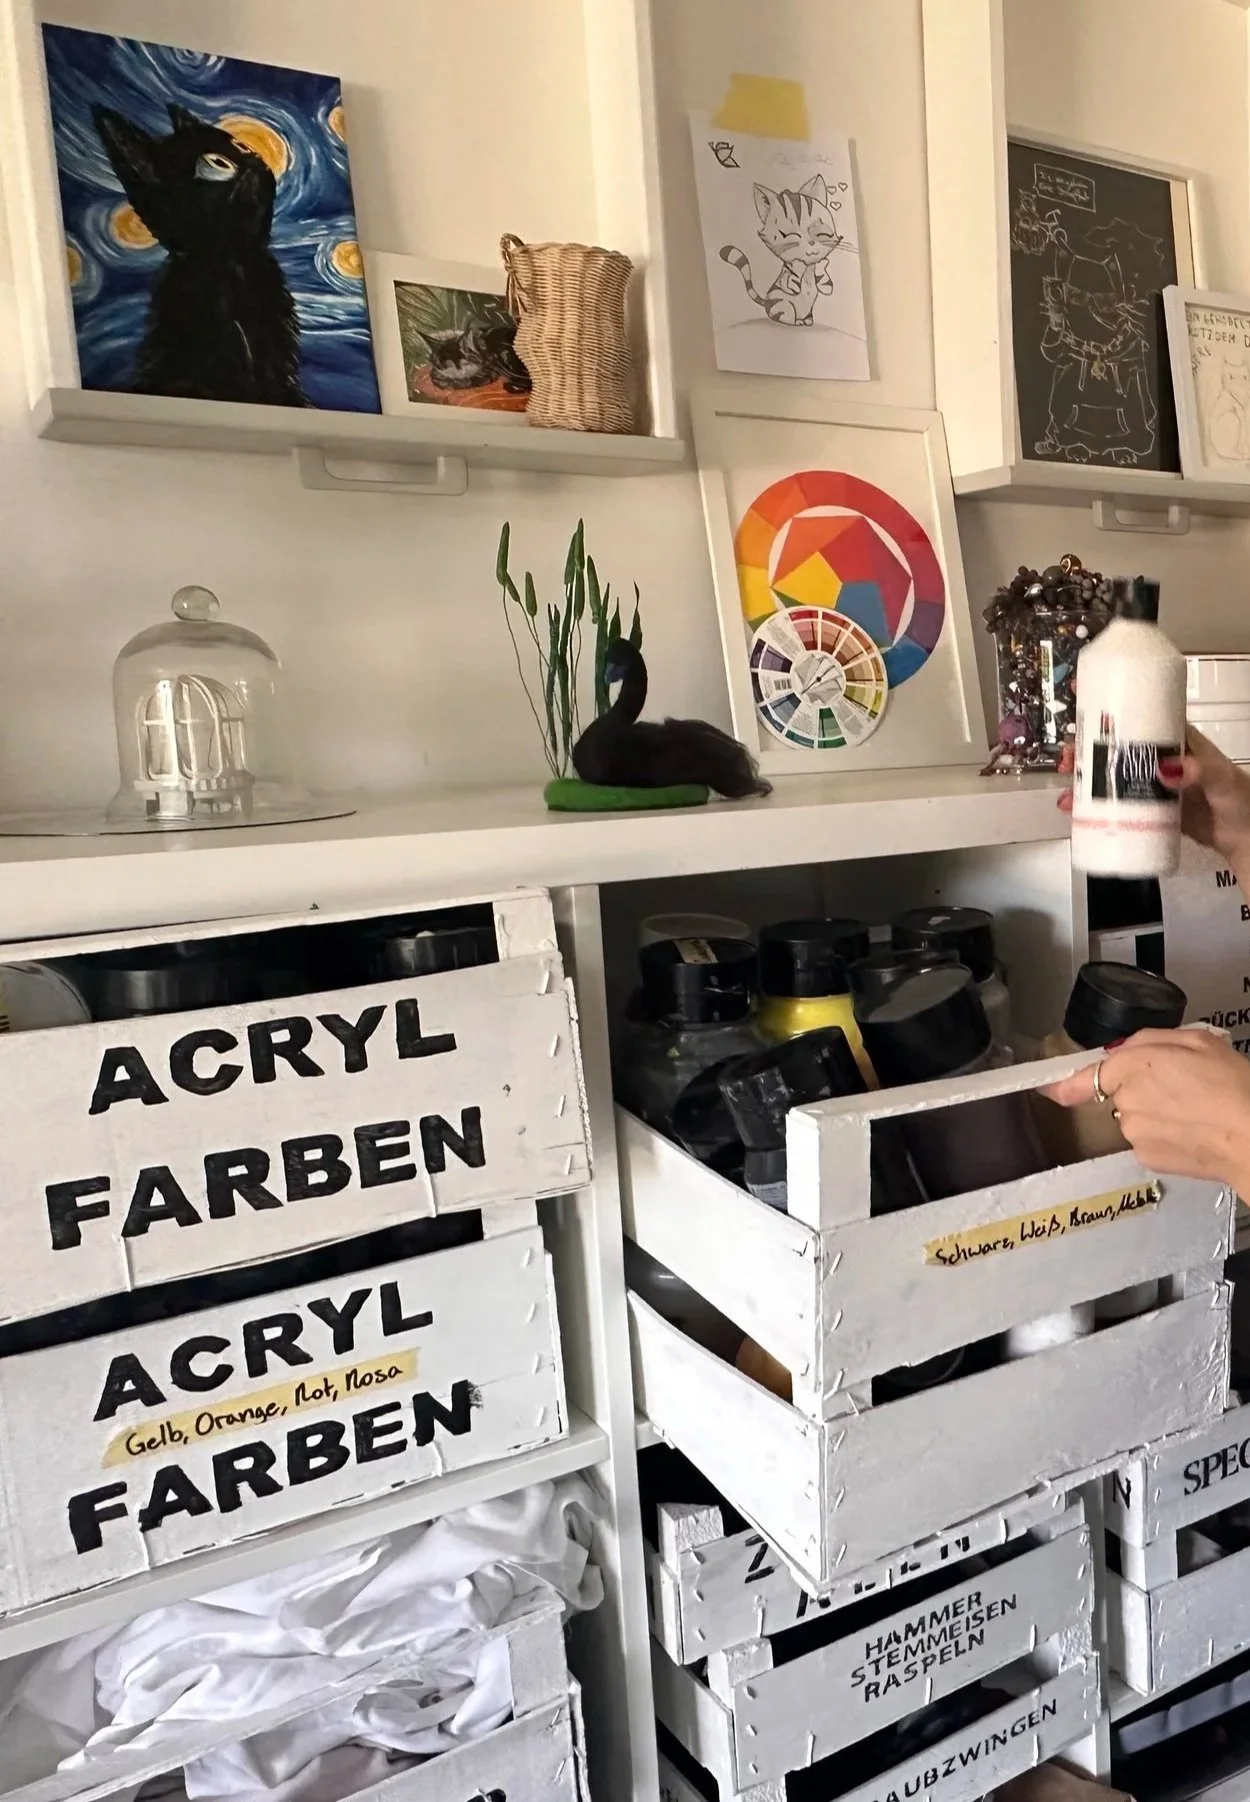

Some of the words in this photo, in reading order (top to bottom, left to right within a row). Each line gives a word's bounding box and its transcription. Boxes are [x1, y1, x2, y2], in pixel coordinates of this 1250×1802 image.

[88, 998, 457, 1115] ACRYL
[45, 1106, 486, 1250] FARBEN
[93, 1281, 433, 1421] ACRYL
[125, 1423, 189, 1456] Gelb,
[194, 1402, 288, 1437] Orange,
[294, 1377, 339, 1407] Rot,
[345, 1365, 403, 1393] Rosa
[68, 1379, 474, 1554] FARBEN
[850, 1593, 1017, 1688] STEMMEISEN
[864, 1590, 982, 1660] HAMMER
[864, 1628, 985, 1703] RASPELN
[873, 1698, 1057, 1802] AUBZWINGEN
